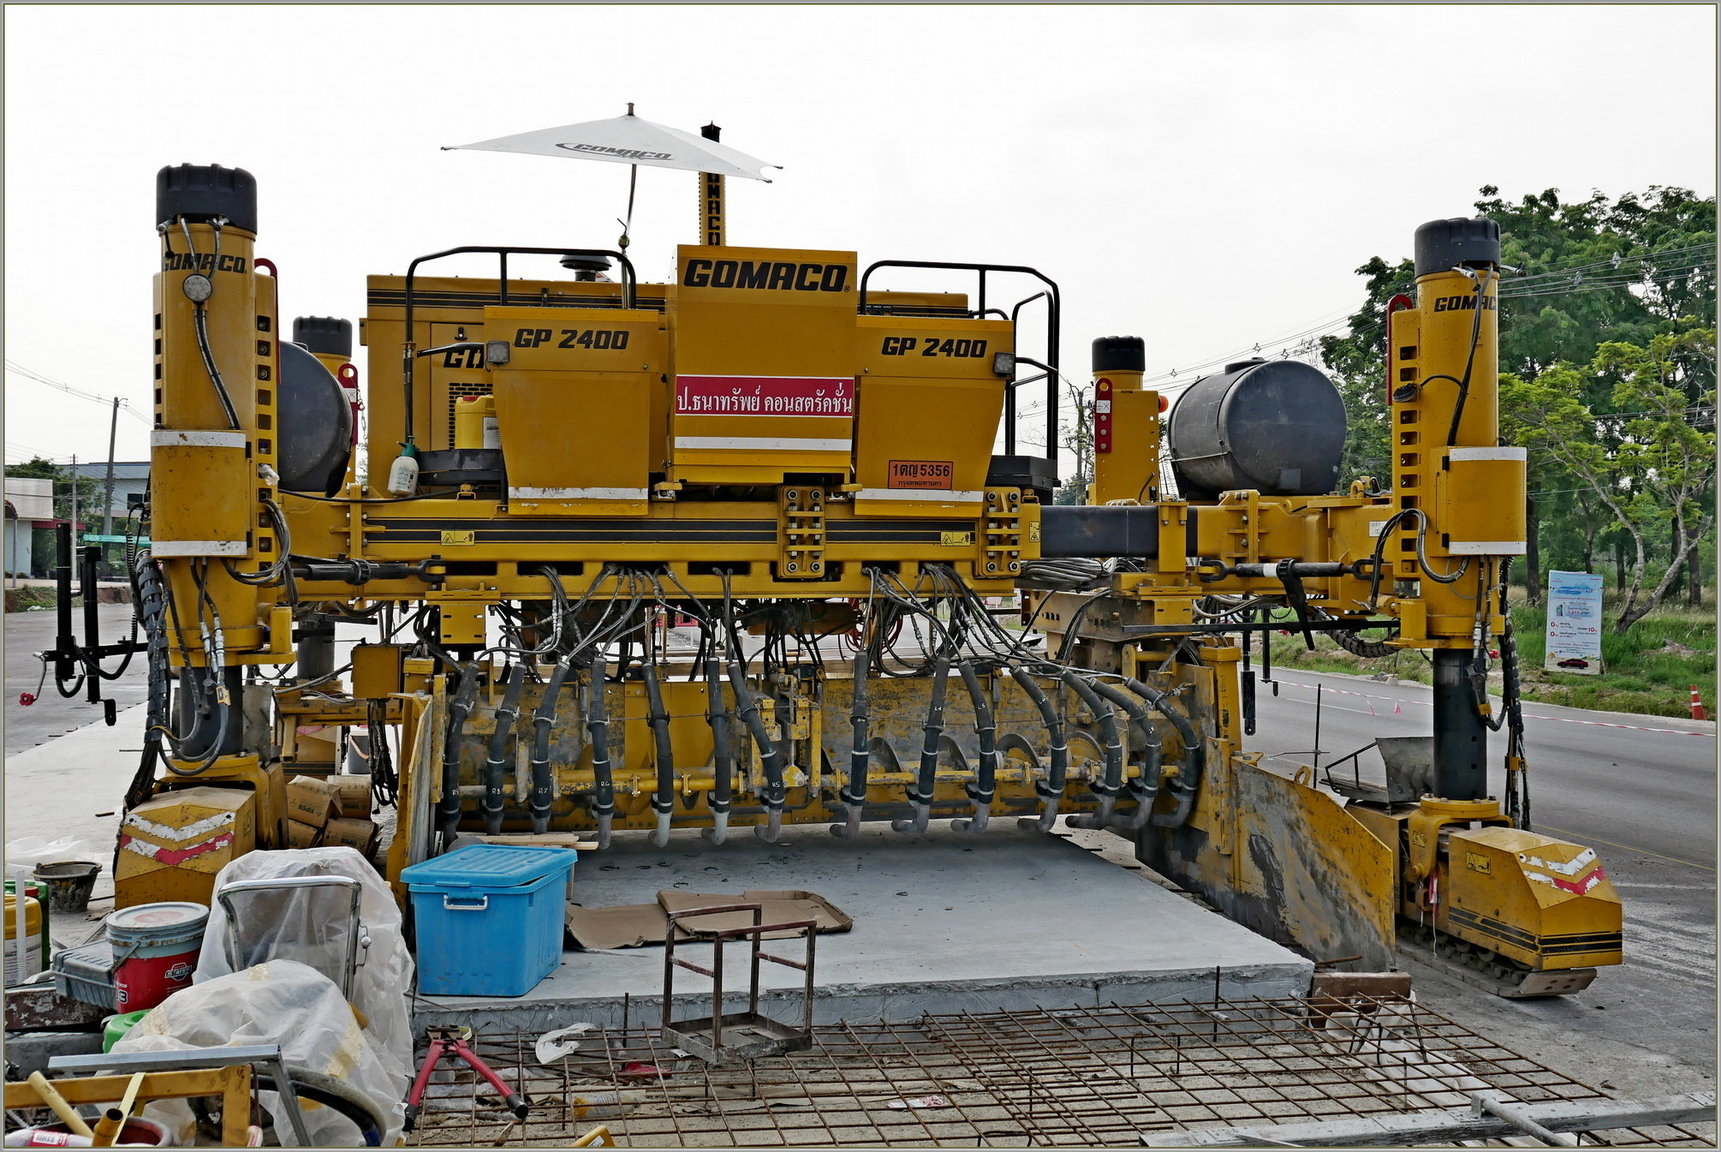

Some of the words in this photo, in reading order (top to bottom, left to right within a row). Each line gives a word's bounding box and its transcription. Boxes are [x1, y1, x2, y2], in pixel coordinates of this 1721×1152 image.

[572, 143, 673, 160] GOMACO
[163, 252, 247, 274] OMACO
[683, 259, 848, 293] GOMACO
[514, 328, 552, 349] GP
[558, 328, 630, 350] 2400
[881, 336, 917, 356] GP
[921, 337, 988, 358] 2400
[677, 384, 761, 412] ป.ธนาทรัพย์
[764, 382, 852, 413] คอนสตรัคชั่น
[920, 464, 950, 477] 5356
